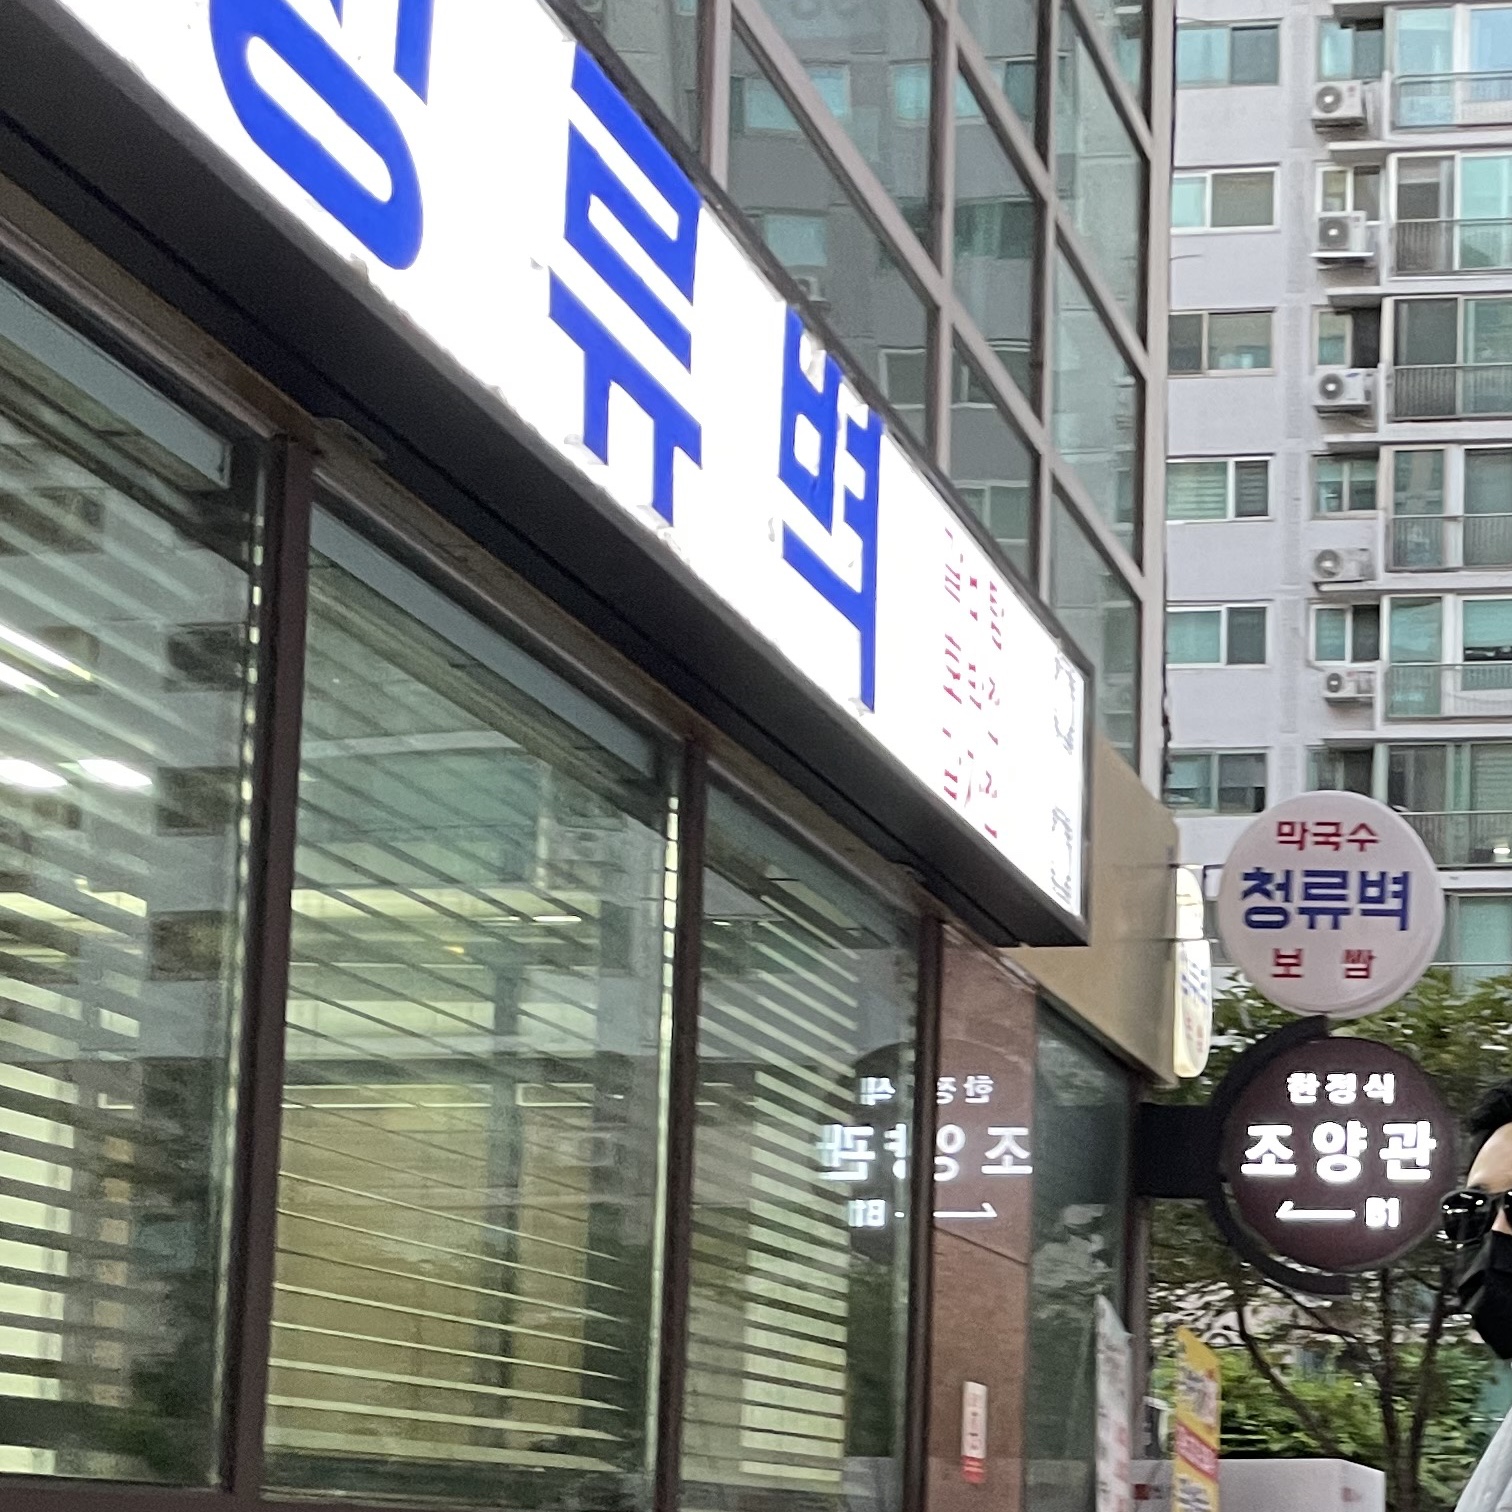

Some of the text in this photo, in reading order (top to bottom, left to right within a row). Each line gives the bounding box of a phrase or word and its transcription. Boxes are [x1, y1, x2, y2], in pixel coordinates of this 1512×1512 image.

[1275, 819, 1380, 852] 막국수
[1240, 867, 1411, 932] 청류벽
[1286, 1071, 1395, 1105] 한정식
[1240, 1119, 1437, 1184] 조양관
